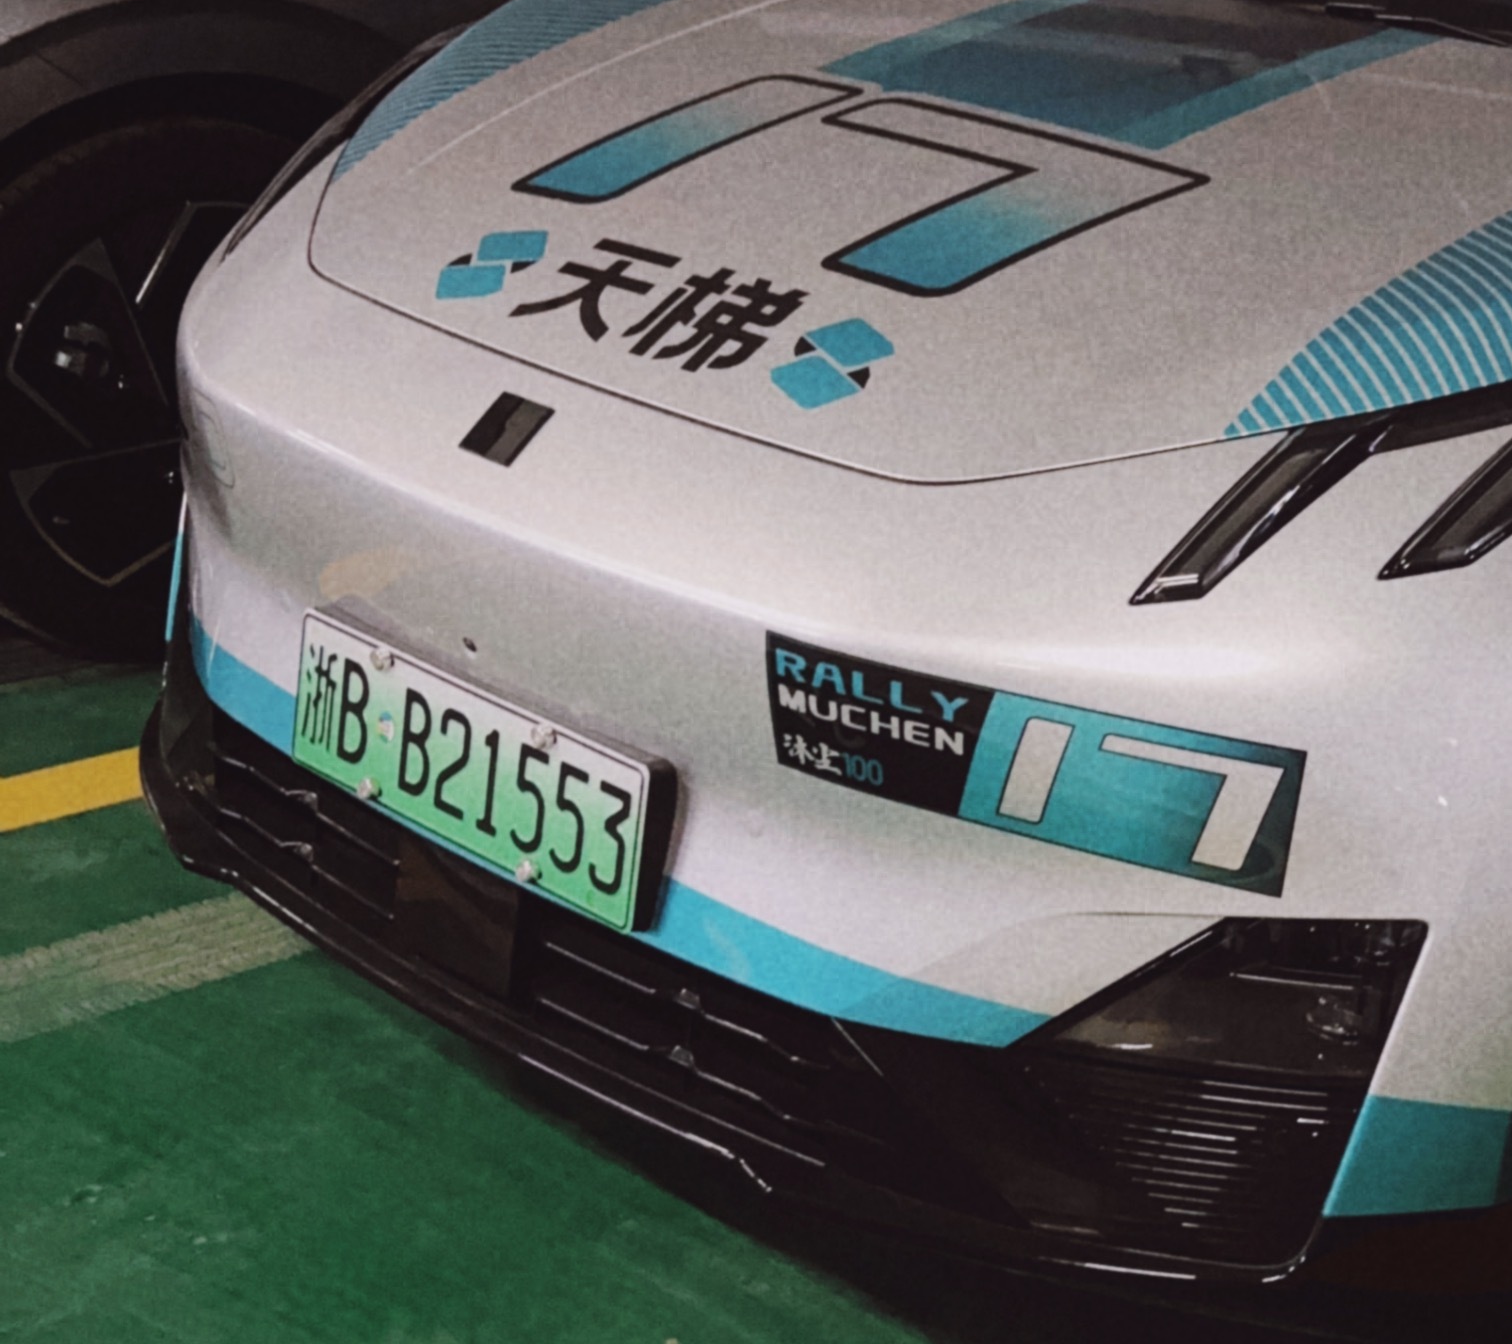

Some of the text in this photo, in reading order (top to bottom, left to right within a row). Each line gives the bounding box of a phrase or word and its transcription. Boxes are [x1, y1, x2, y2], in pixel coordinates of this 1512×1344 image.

[509, 73, 1211, 298] 17
[508, 237, 811, 374] 天梯
[775, 647, 969, 724] RALLY
[777, 683, 965, 757] MUCHEN
[996, 716, 1285, 873] 17
